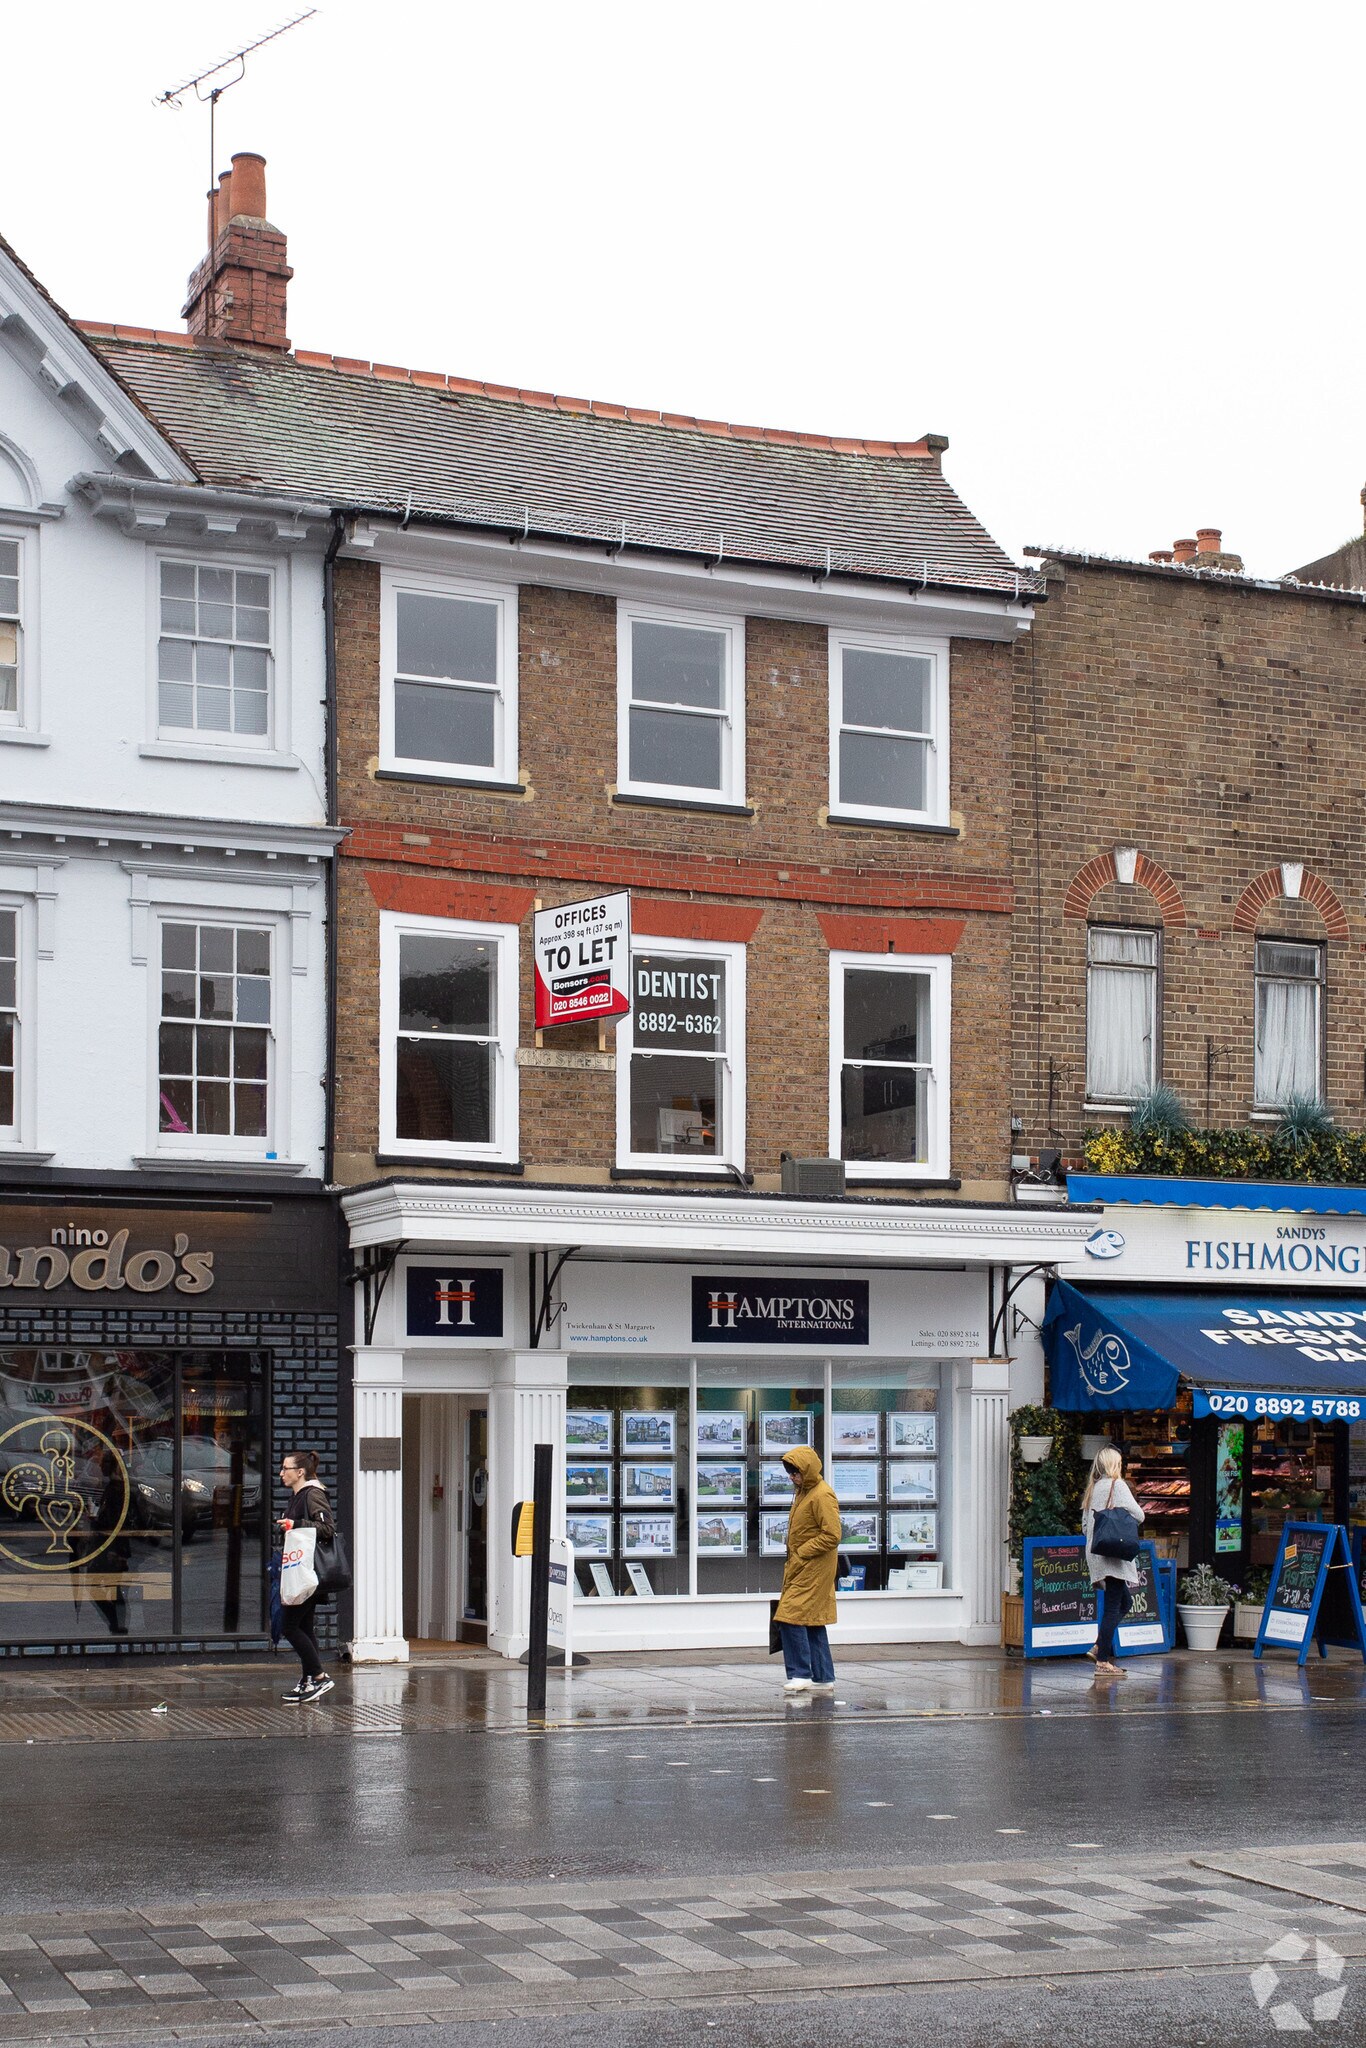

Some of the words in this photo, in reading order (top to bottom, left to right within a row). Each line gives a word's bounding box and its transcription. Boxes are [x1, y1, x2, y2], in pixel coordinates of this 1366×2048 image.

[554, 904, 607, 929] OFFICES
[539, 934, 562, 947] Approx
[563, 929, 576, 940] 398
[576, 930, 585, 939] sq
[585, 926, 592, 935] ft
[592, 923, 603, 936] (37
[604, 924, 613, 932] sq
[614, 919, 623, 930] m)
[544, 945, 571, 972] TO
[579, 935, 618, 967] LET
[553, 973, 609, 991] Bonsors.com
[637, 970, 721, 1000] DENTIST
[553, 1000, 568, 1011] 020
[568, 995, 588, 1008] 8546
[589, 992, 609, 1005] 0022
[638, 1011, 722, 1035] 8892-6362
[516, 1049, 552, 1066] KING
[555, 1051, 615, 1070] STREET
[51, 1222, 109, 1246] nino
[1276, 1226, 1326, 1241] SANDYS
[1185, 1240, 1366, 1274] FISHMONG
[708, 1290, 855, 1328] HAMPTONS
[566, 1322, 607, 1330] Twickenham
[625, 1323, 656, 1332] Margarets
[776, 1319, 854, 1330] INTERNATIONAL
[569, 1333, 649, 1344] www.hamptons.co.uk
[937, 1331, 949, 1339] 020
[949, 1331, 964, 1339] 8892
[964, 1331, 980, 1339] 8144
[937, 1340, 949, 1348] 020
[949, 1340, 964, 1348] 8892
[964, 1340, 980, 1348] 7236
[1199, 1328, 1366, 1346] FRESH
[1209, 1395, 1249, 1413] 020
[1254, 1397, 1306, 1415] 8892
[1311, 1399, 1361, 1417] 5788
[1040, 1563, 1055, 1577] COD
[1054, 1561, 1079, 1574] FILLETS
[548, 1607, 563, 1626] Open
